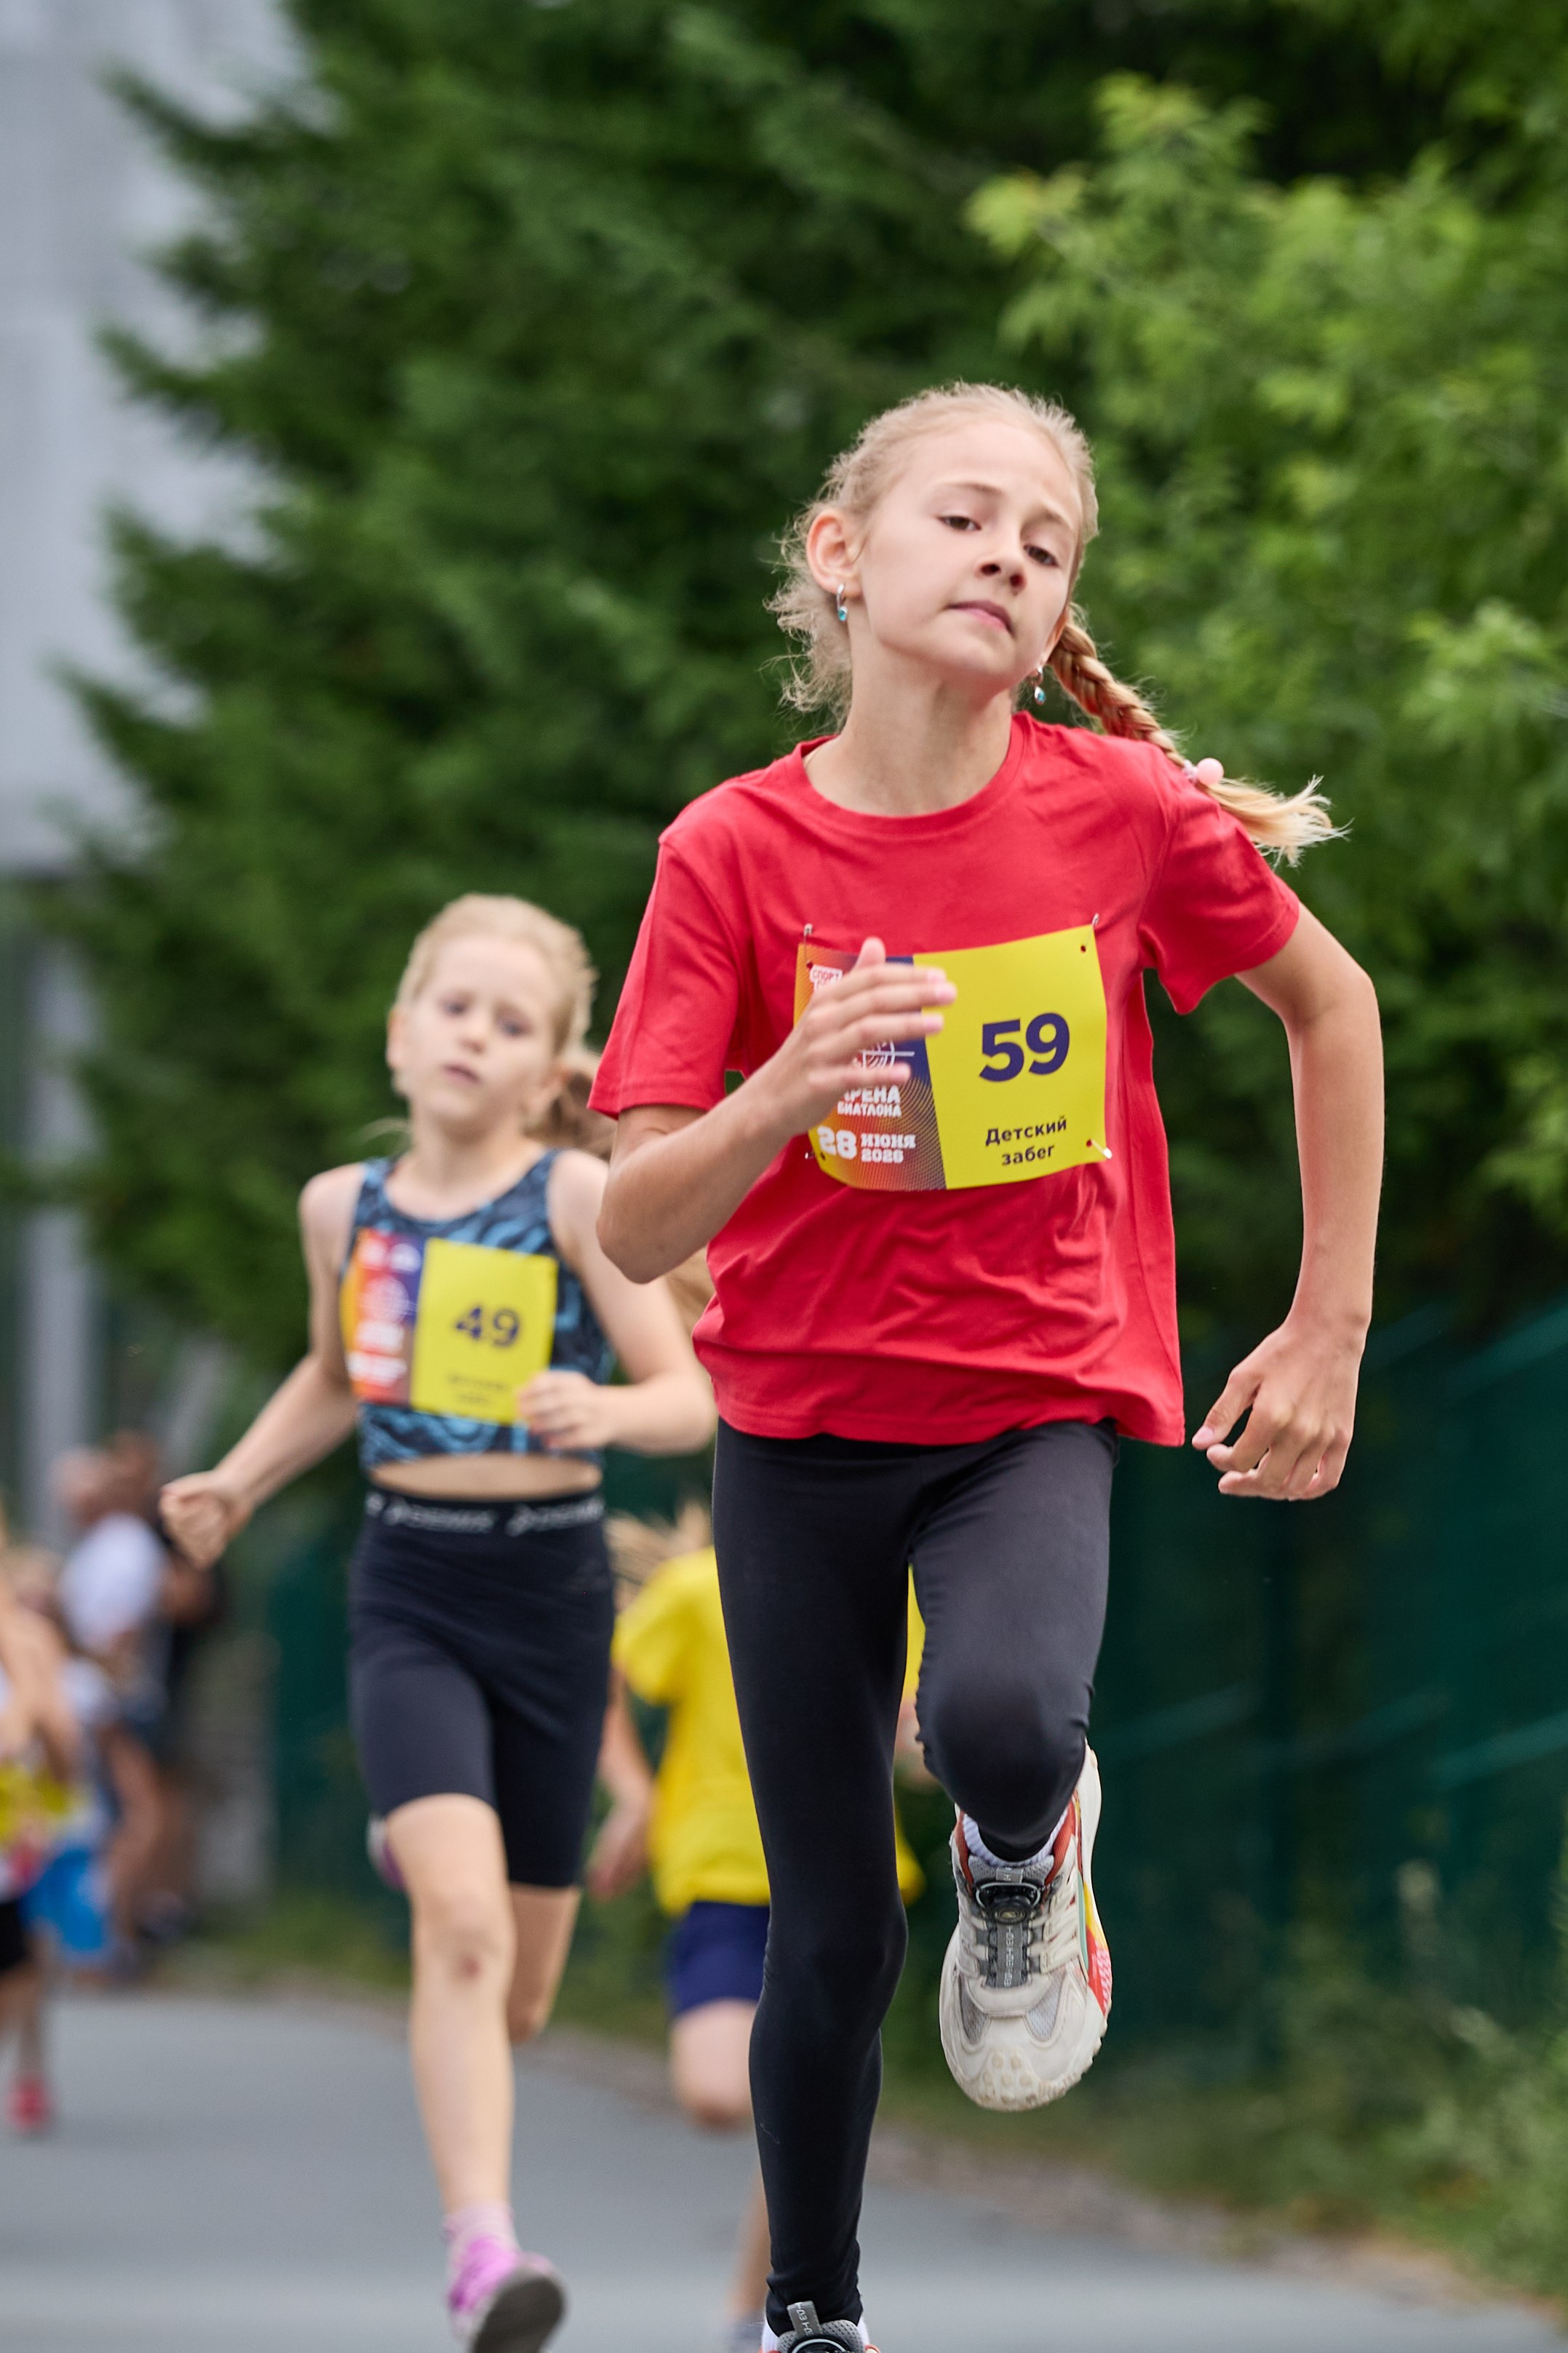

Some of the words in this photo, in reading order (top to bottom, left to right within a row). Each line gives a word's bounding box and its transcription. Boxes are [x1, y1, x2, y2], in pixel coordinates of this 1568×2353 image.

[978, 1012, 1070, 1082] 59
[837, 1100, 902, 1118] БИАТЛОНА
[817, 1125, 857, 1160] 28
[860, 1132, 917, 1148] ИЮНЯ
[985, 1114, 1067, 1147] Детский
[1001, 1144, 1055, 1166] забег
[455, 1305, 522, 1349] 49
